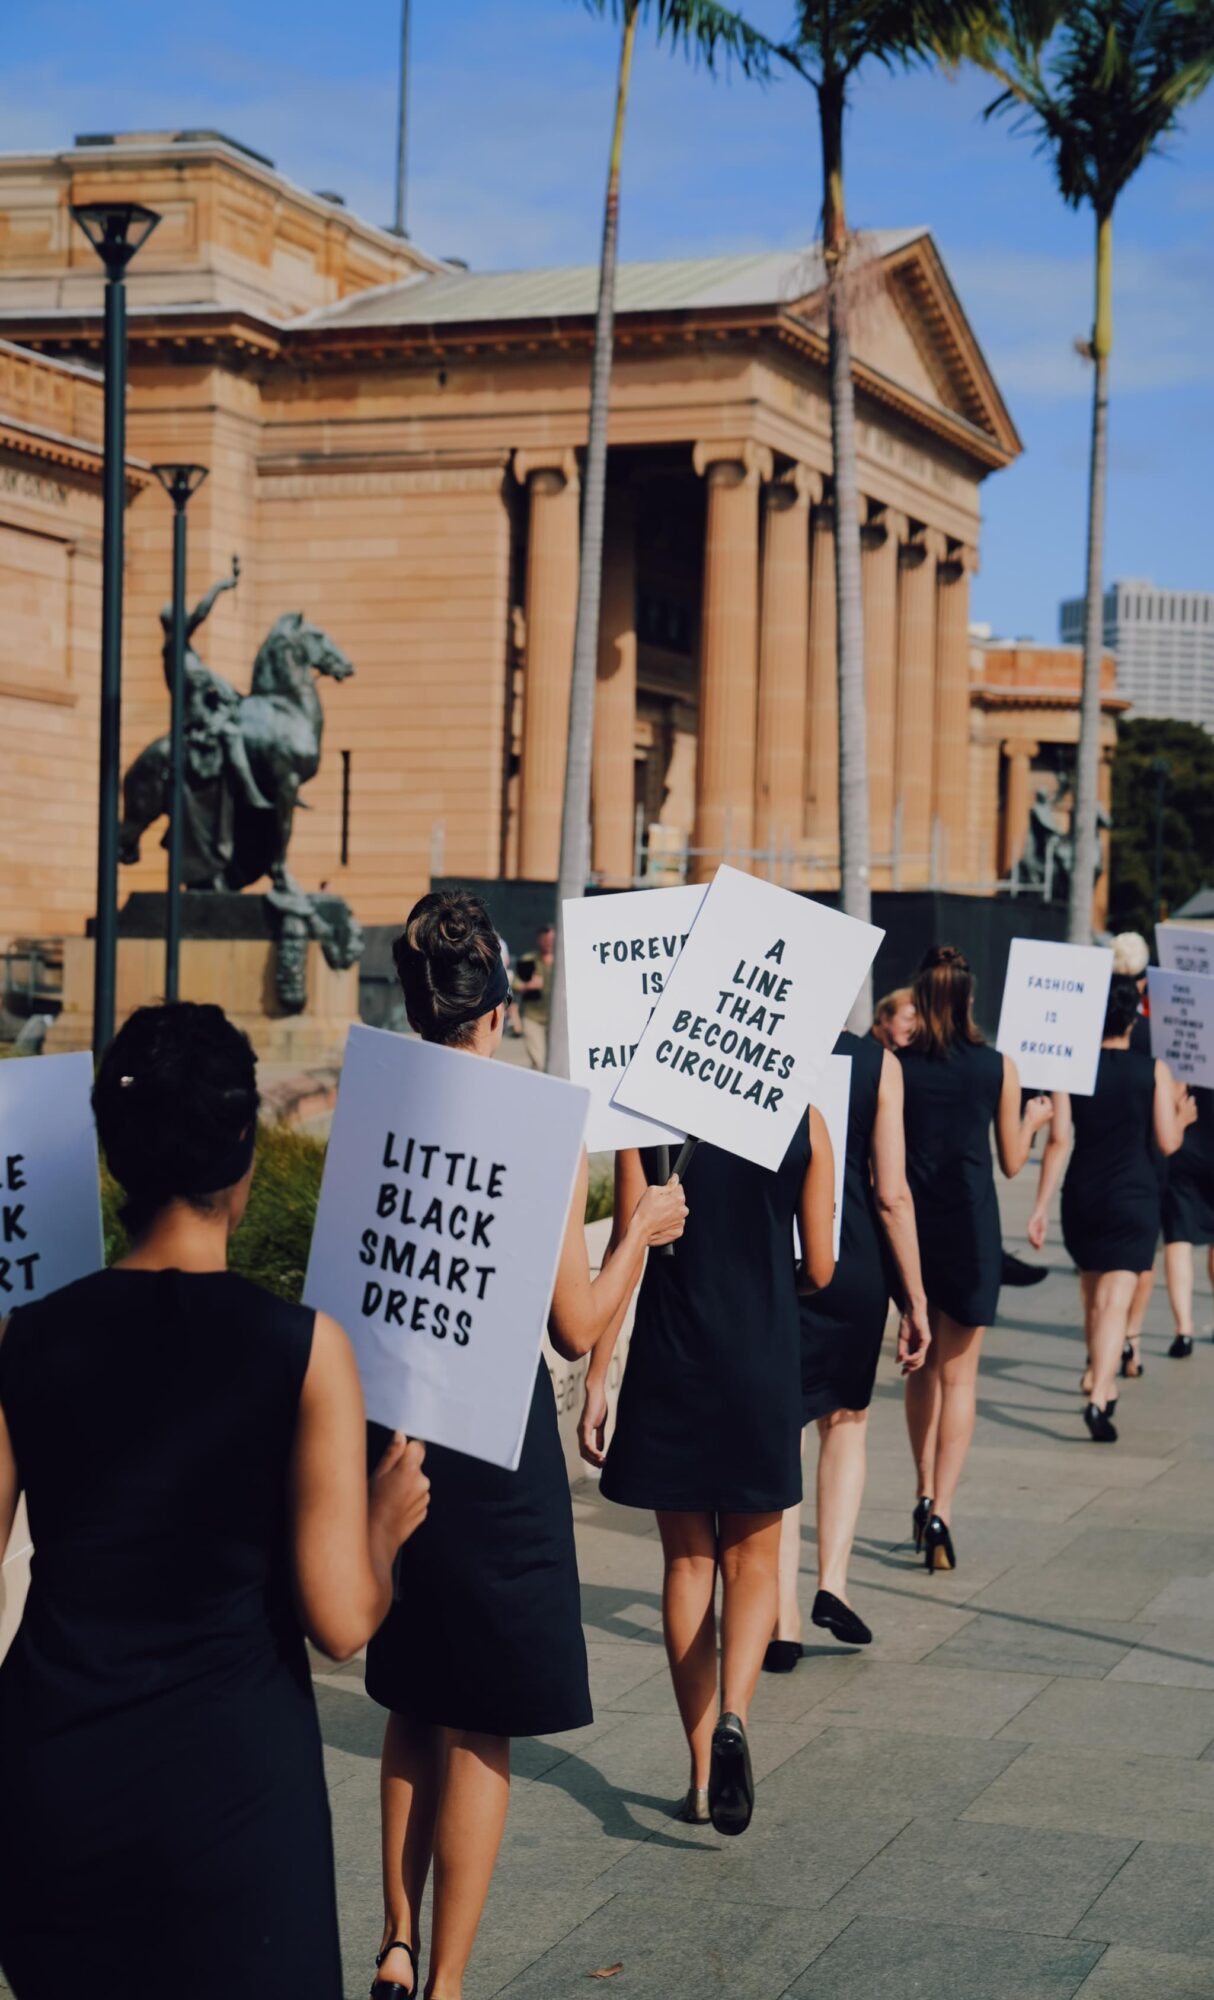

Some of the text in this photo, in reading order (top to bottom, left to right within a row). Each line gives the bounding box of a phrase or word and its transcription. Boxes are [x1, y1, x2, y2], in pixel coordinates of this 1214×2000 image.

[765, 939, 785, 964] A
[642, 971, 664, 995] IS
[733, 960, 792, 1001] LINE
[1027, 975, 1085, 994] FASHION
[717, 991, 785, 1035] THAT
[1045, 1010, 1057, 1024] IS
[673, 1011, 794, 1079] BECOMES
[1020, 1040, 1074, 1058] BROKEN
[657, 1041, 783, 1112] CIRCULAR
[0, 1153, 27, 1192] E
[383, 1132, 506, 1198] LITTLE
[376, 1183, 494, 1248] BLACK
[359, 1228, 495, 1299] SMART
[361, 1281, 471, 1346] DRESS
